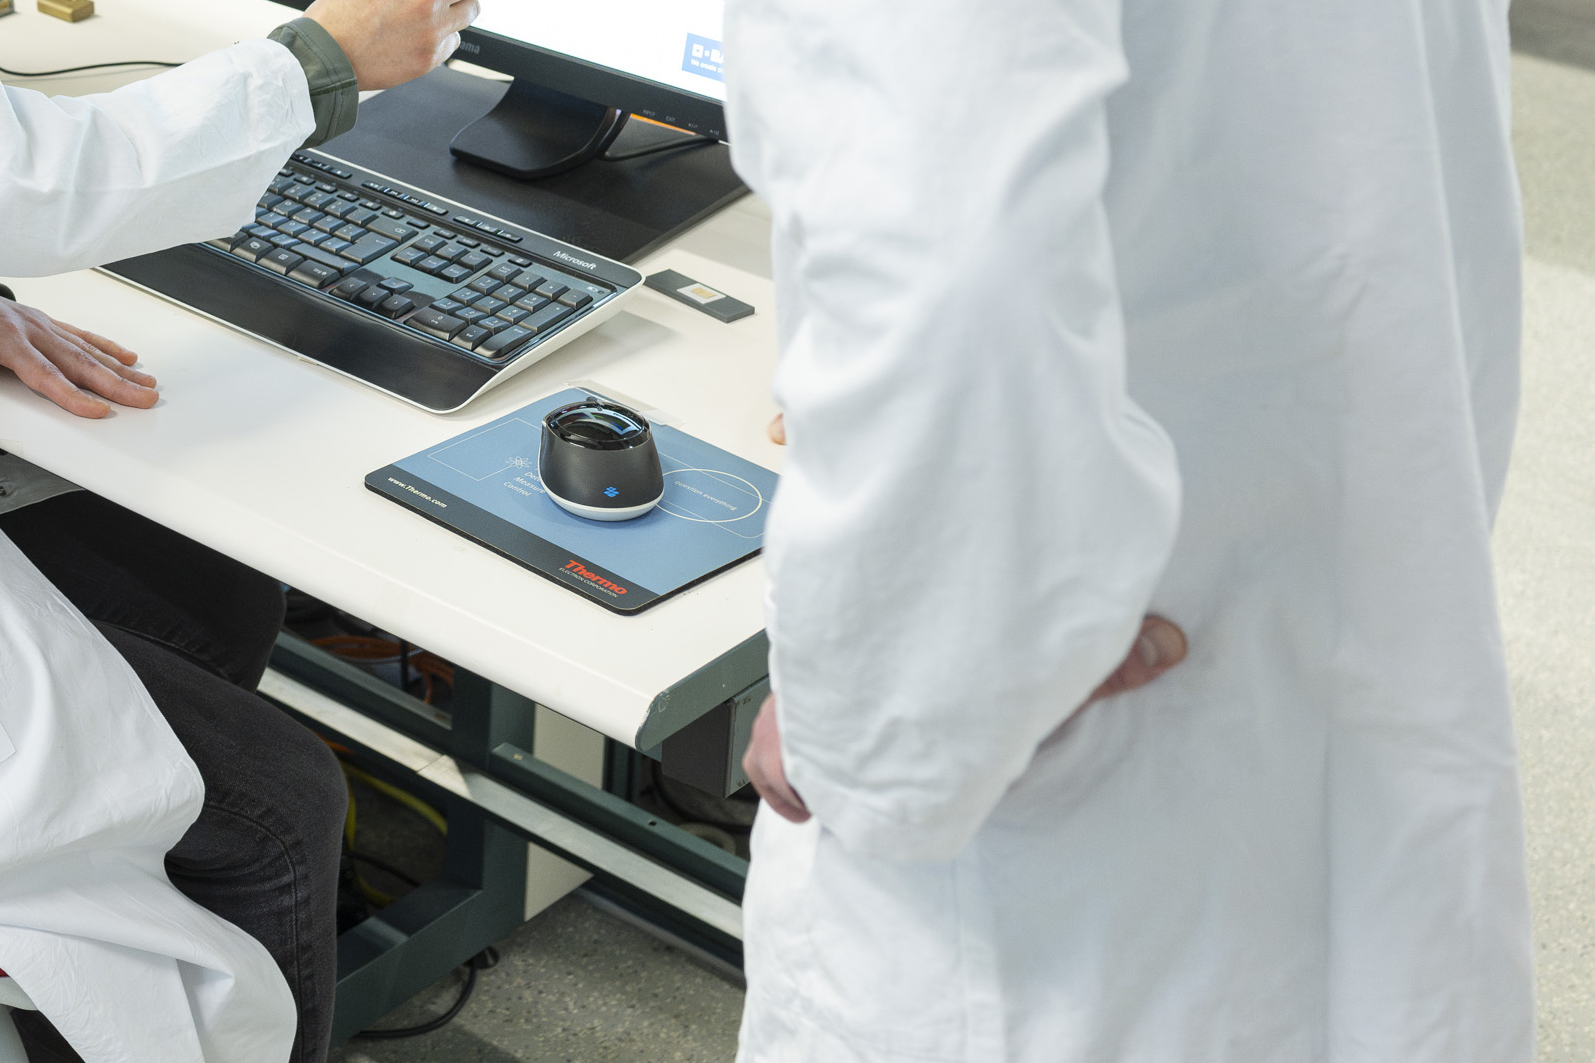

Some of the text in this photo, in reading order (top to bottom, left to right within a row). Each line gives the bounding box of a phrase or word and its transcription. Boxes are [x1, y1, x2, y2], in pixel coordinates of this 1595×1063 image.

[553, 250, 597, 270] Microsoft
[387, 476, 447, 509] www.Thermo.com
[503, 481, 532, 497] Control
[513, 476, 546, 494] Measure
[674, 480, 738, 512] question everything
[558, 567, 619, 598] ELECTRON CORPORATION
[564, 559, 628, 595] Thermo
